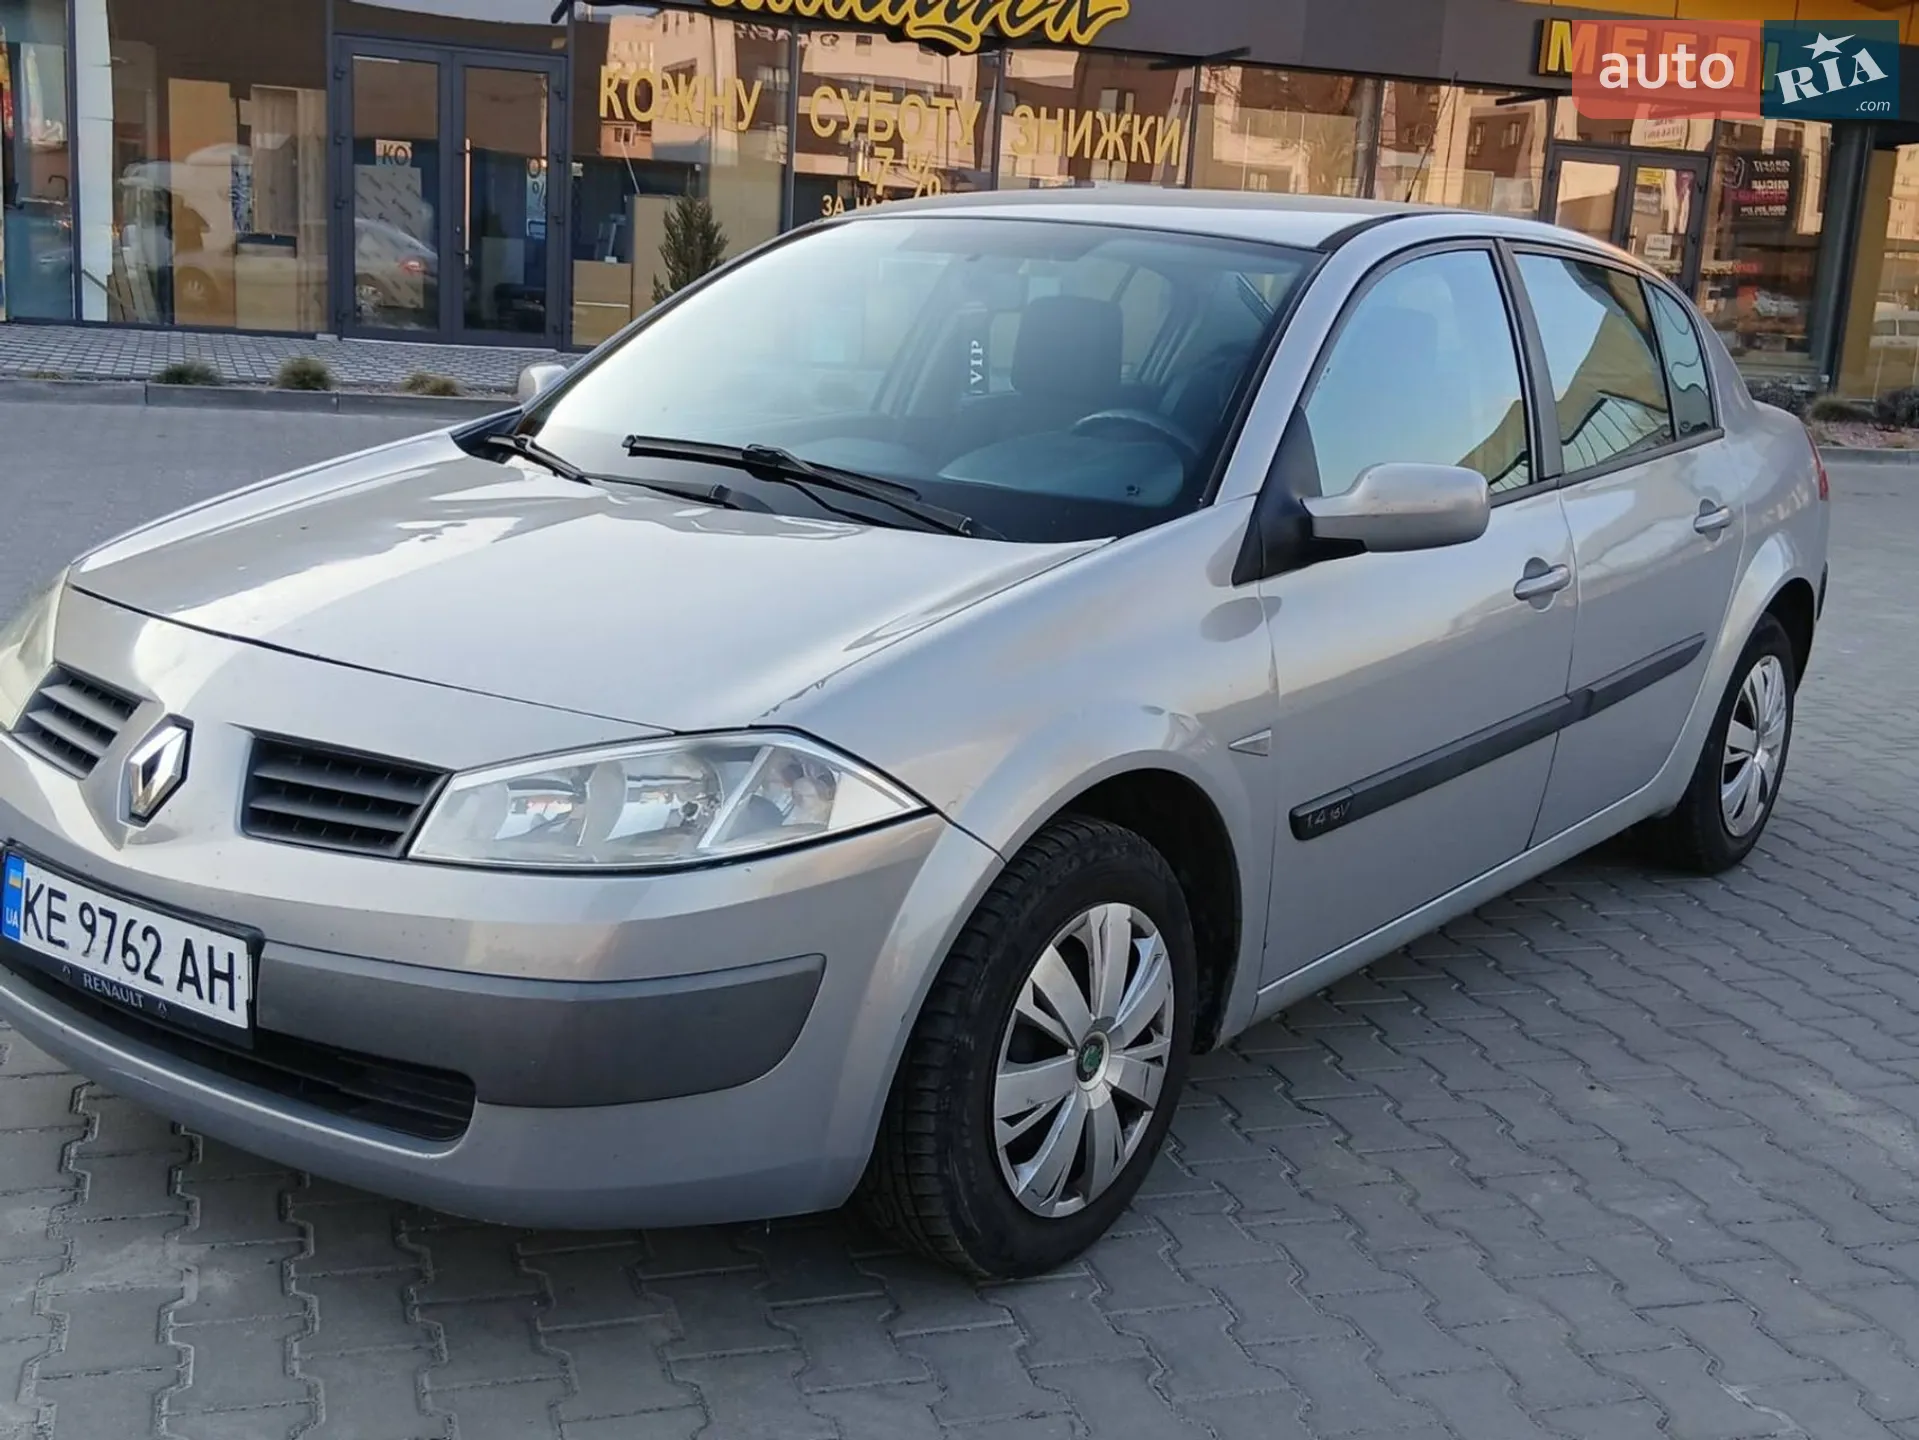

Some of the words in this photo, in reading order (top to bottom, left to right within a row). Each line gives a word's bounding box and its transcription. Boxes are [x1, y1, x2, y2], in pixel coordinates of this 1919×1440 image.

[599, 66, 763, 133] КОЖНУ
[810, 85, 982, 148] СУБОТУ
[1011, 104, 1181, 167] ЗНИЖКИ
[970, 340, 983, 385] VIP
[5, 909, 19, 929] UA
[23, 877, 69, 950] KE
[78, 901, 165, 987] 9762
[176, 937, 236, 1013] AH
[83, 972, 145, 1010] RENAULT
